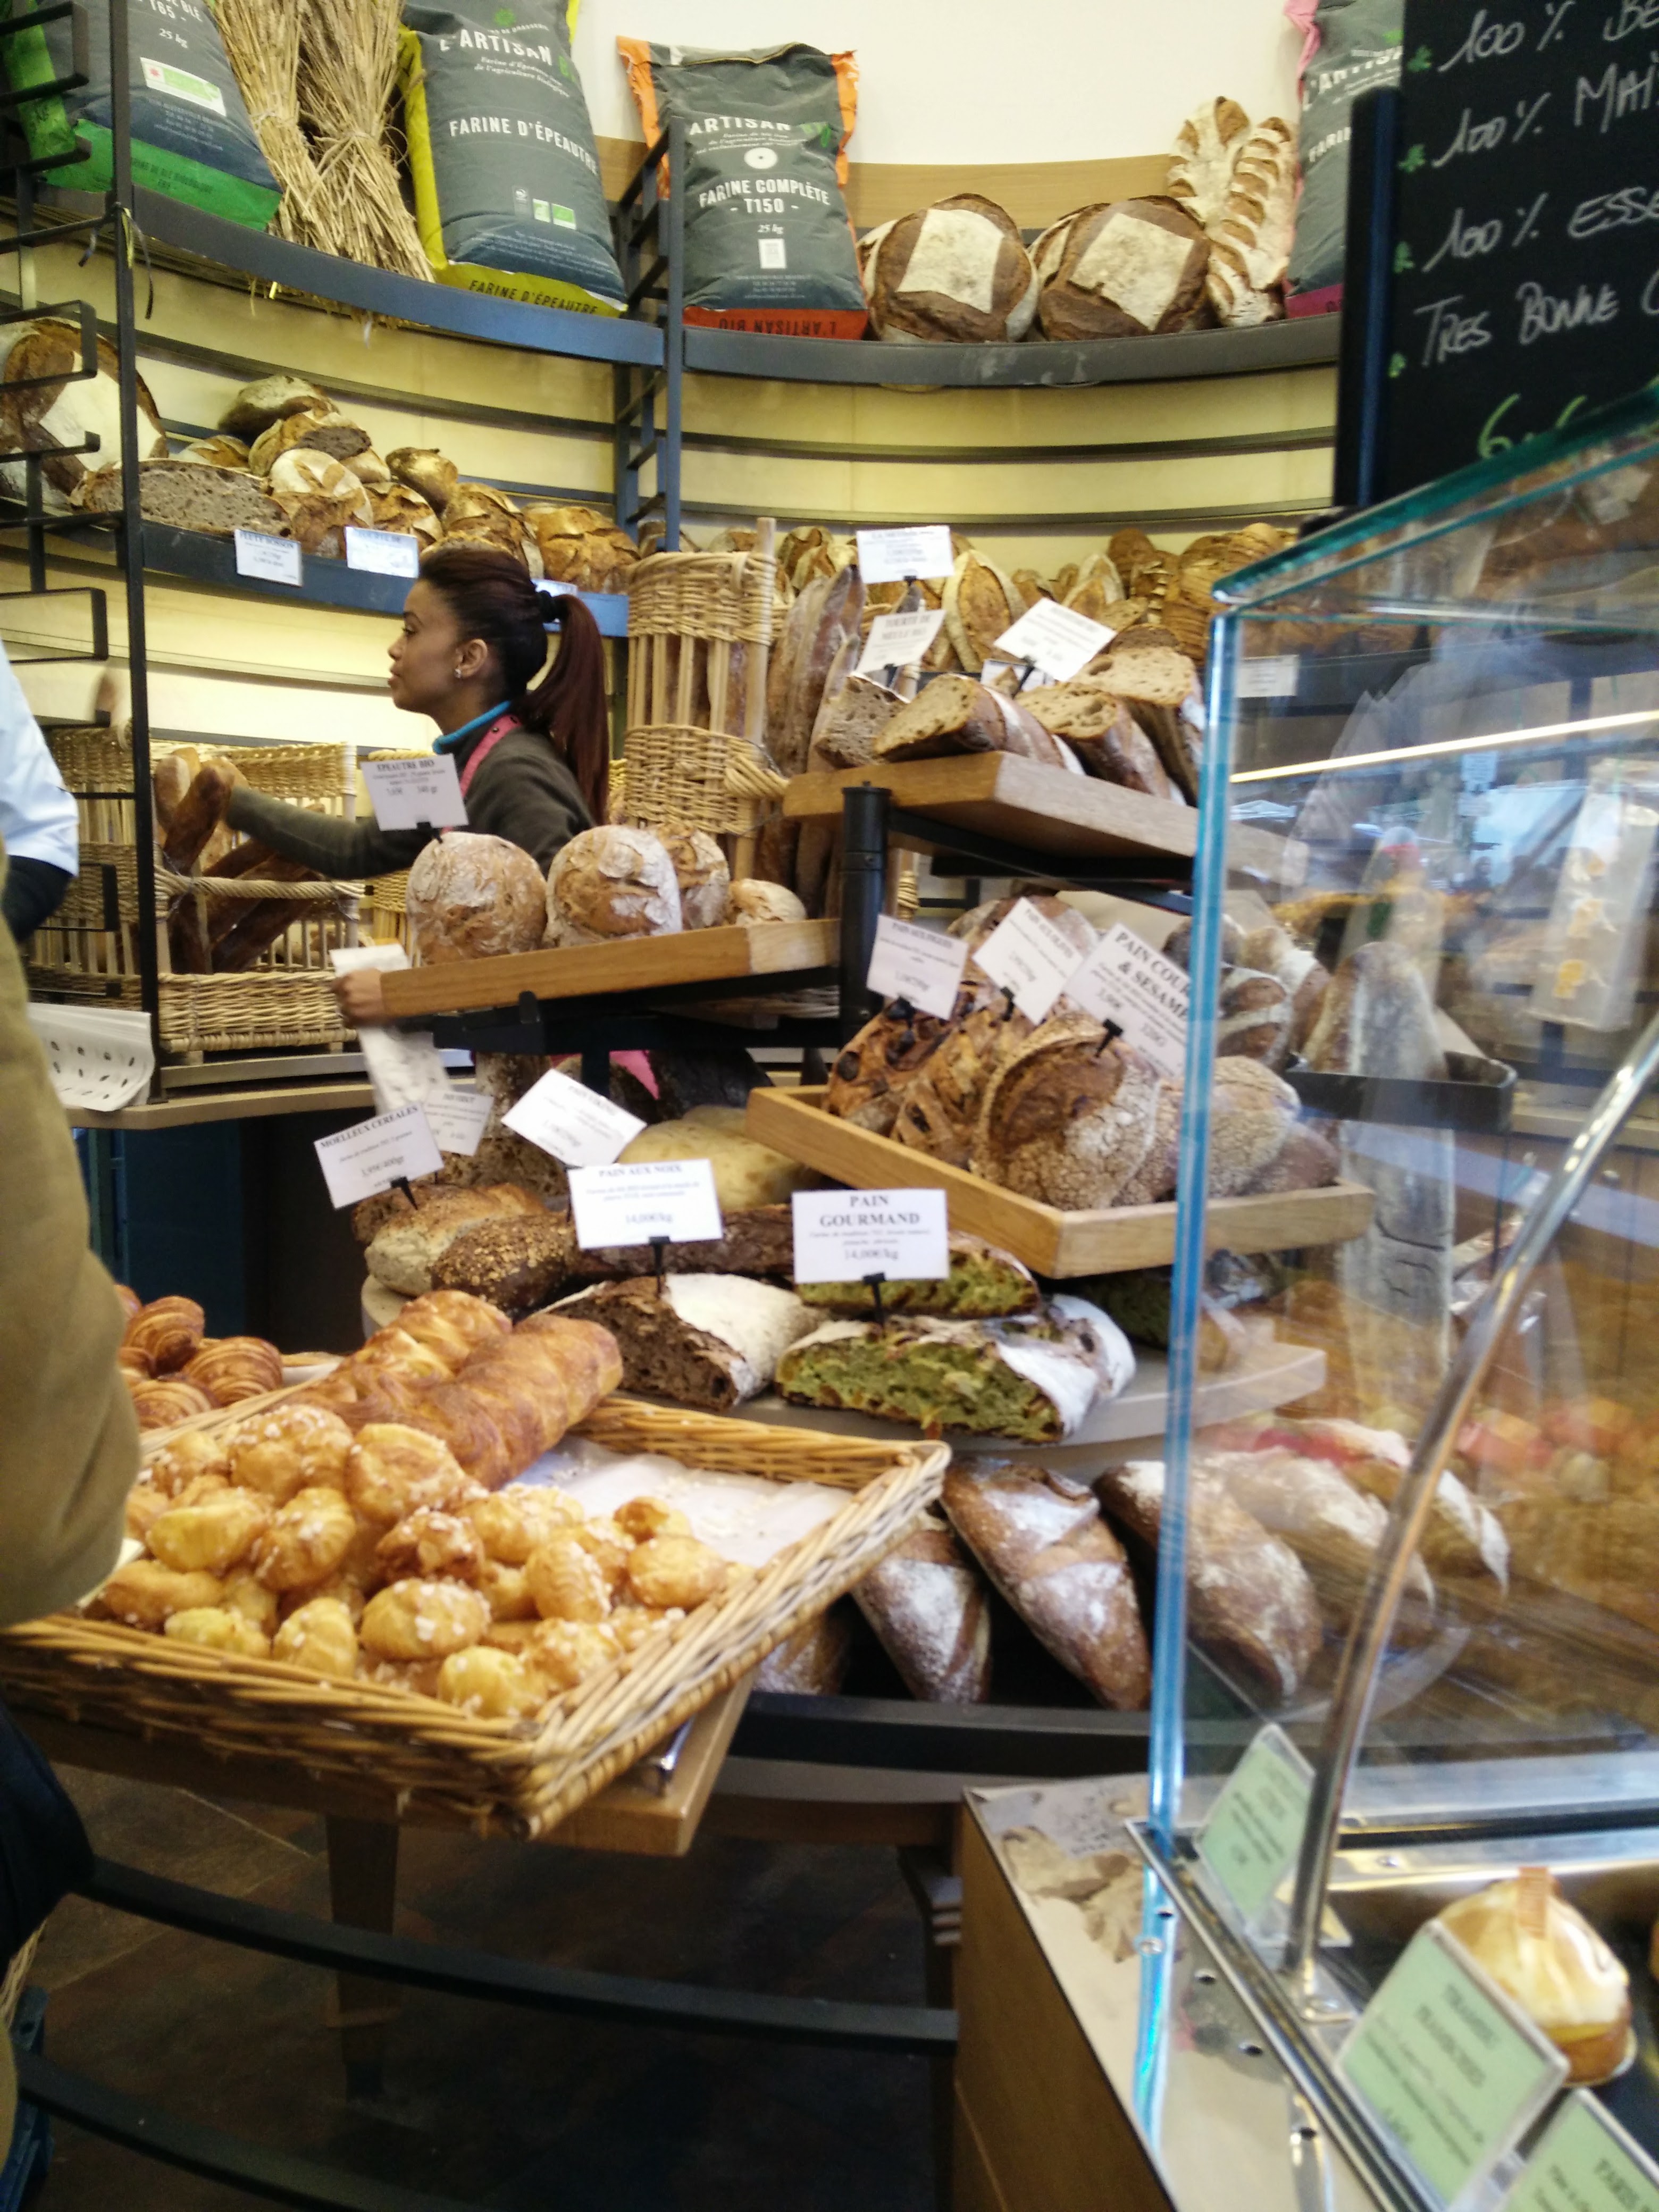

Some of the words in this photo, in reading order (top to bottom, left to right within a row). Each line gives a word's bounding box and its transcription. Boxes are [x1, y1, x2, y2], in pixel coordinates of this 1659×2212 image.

[160, 28, 172, 39] 25
[1438, 9, 1525, 73] 100
[1432, 107, 1507, 168] 100
[1512, 91, 1552, 143] %
[449, 116, 512, 137] FARINE
[517, 120, 598, 175] D'ÉPEAUTRE
[699, 180, 752, 208] FARINE
[755, 179, 831, 206] COMPLÈTE
[743, 198, 785, 213] T150
[757, 224, 770, 233] 25
[1421, 207, 1503, 273] 100
[1512, 192, 1548, 247] %
[469, 280, 517, 300] FARINE
[1115, 931, 1150, 962] PAIN
[320, 1125, 371, 1149] MOELLEUX
[372, 1104, 418, 1130] CEREALES
[599, 1168, 625, 1177] PAIN
[629, 1167, 651, 1176] AUX
[850, 1195, 890, 1208] PAIN
[819, 1212, 920, 1228] GOURMAND
